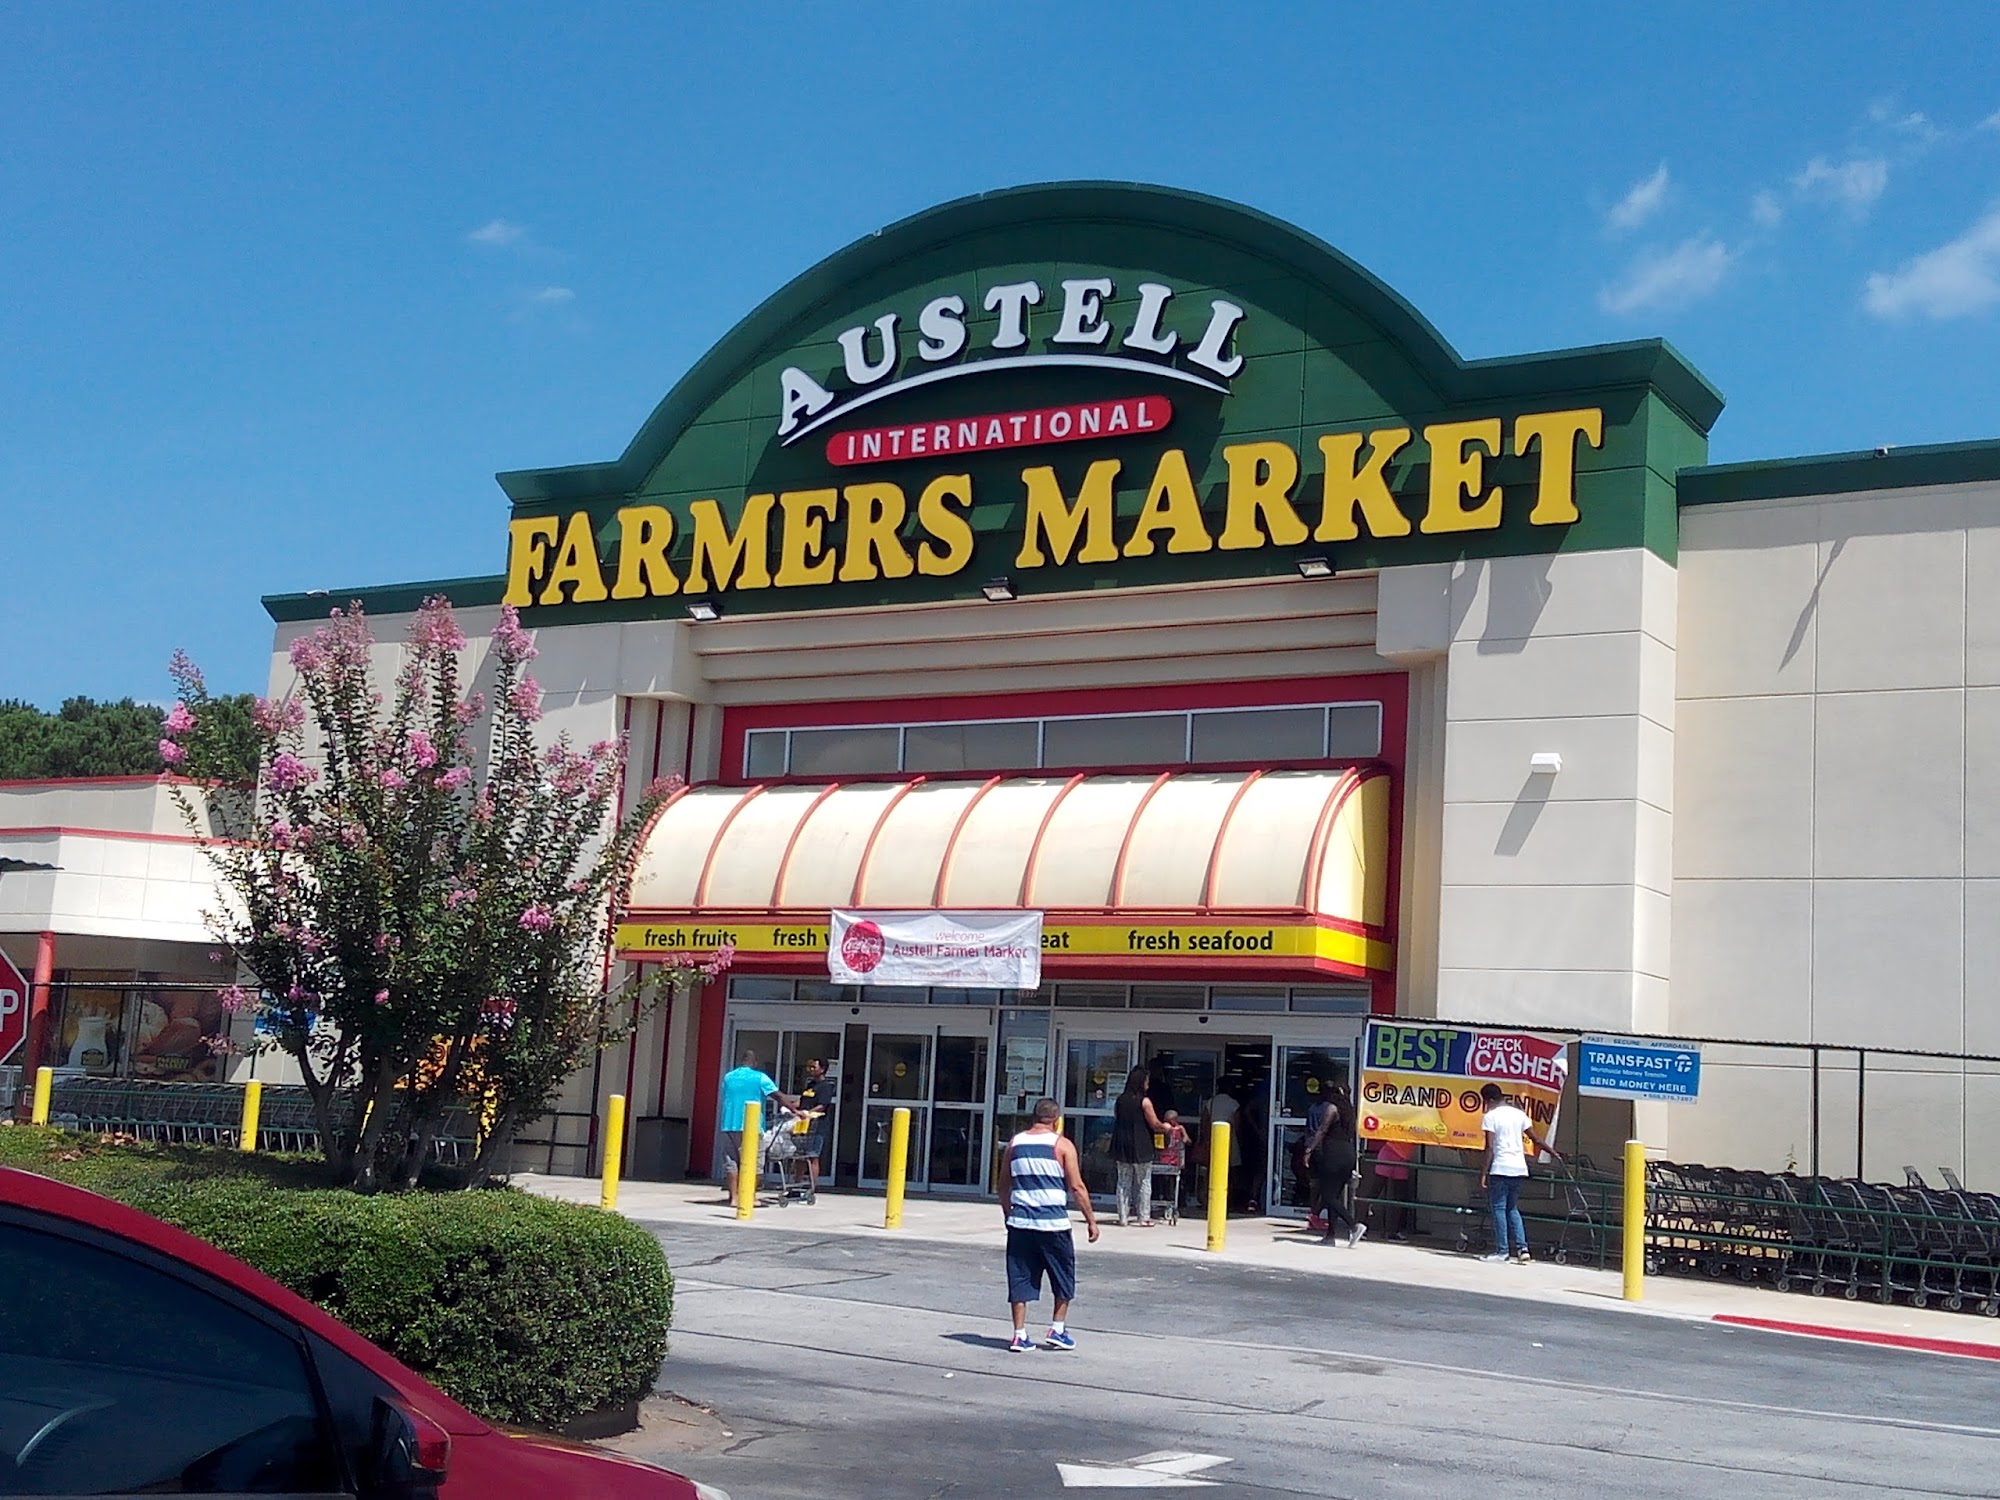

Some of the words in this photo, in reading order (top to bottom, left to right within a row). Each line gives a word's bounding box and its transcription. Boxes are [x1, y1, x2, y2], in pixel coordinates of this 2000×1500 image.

[778, 277, 1245, 436] AUSTELL
[847, 402, 1154, 460] INTERNATIONAL
[502, 473, 974, 608] FARMERS
[1014, 407, 1603, 569] MARKET
[644, 929, 686, 947] fresh
[692, 929, 737, 948] fruits
[773, 927, 817, 946] fresh
[935, 929, 984, 942] welcome
[1041, 931, 1069, 949] eat
[1128, 930, 1180, 950] fresh
[1188, 930, 1274, 951] seafood
[892, 943, 933, 957] Austell
[936, 944, 979, 958] Farmer
[1375, 1026, 1458, 1072] BEST
[1477, 1036, 1523, 1052] CHECK
[1613, 1038, 1640, 1046] SECURE
[1650, 1042, 1696, 1050] AFFORDABLE
[1588, 1051, 1673, 1070] TRANSFAST
[1622, 1067, 1643, 1078] Money
[1590, 1076, 1616, 1087] SEND
[1619, 1079, 1656, 1090] MONEY
[1658, 1083, 1687, 1093] HERE
[1363, 1081, 1452, 1110] GRAND
